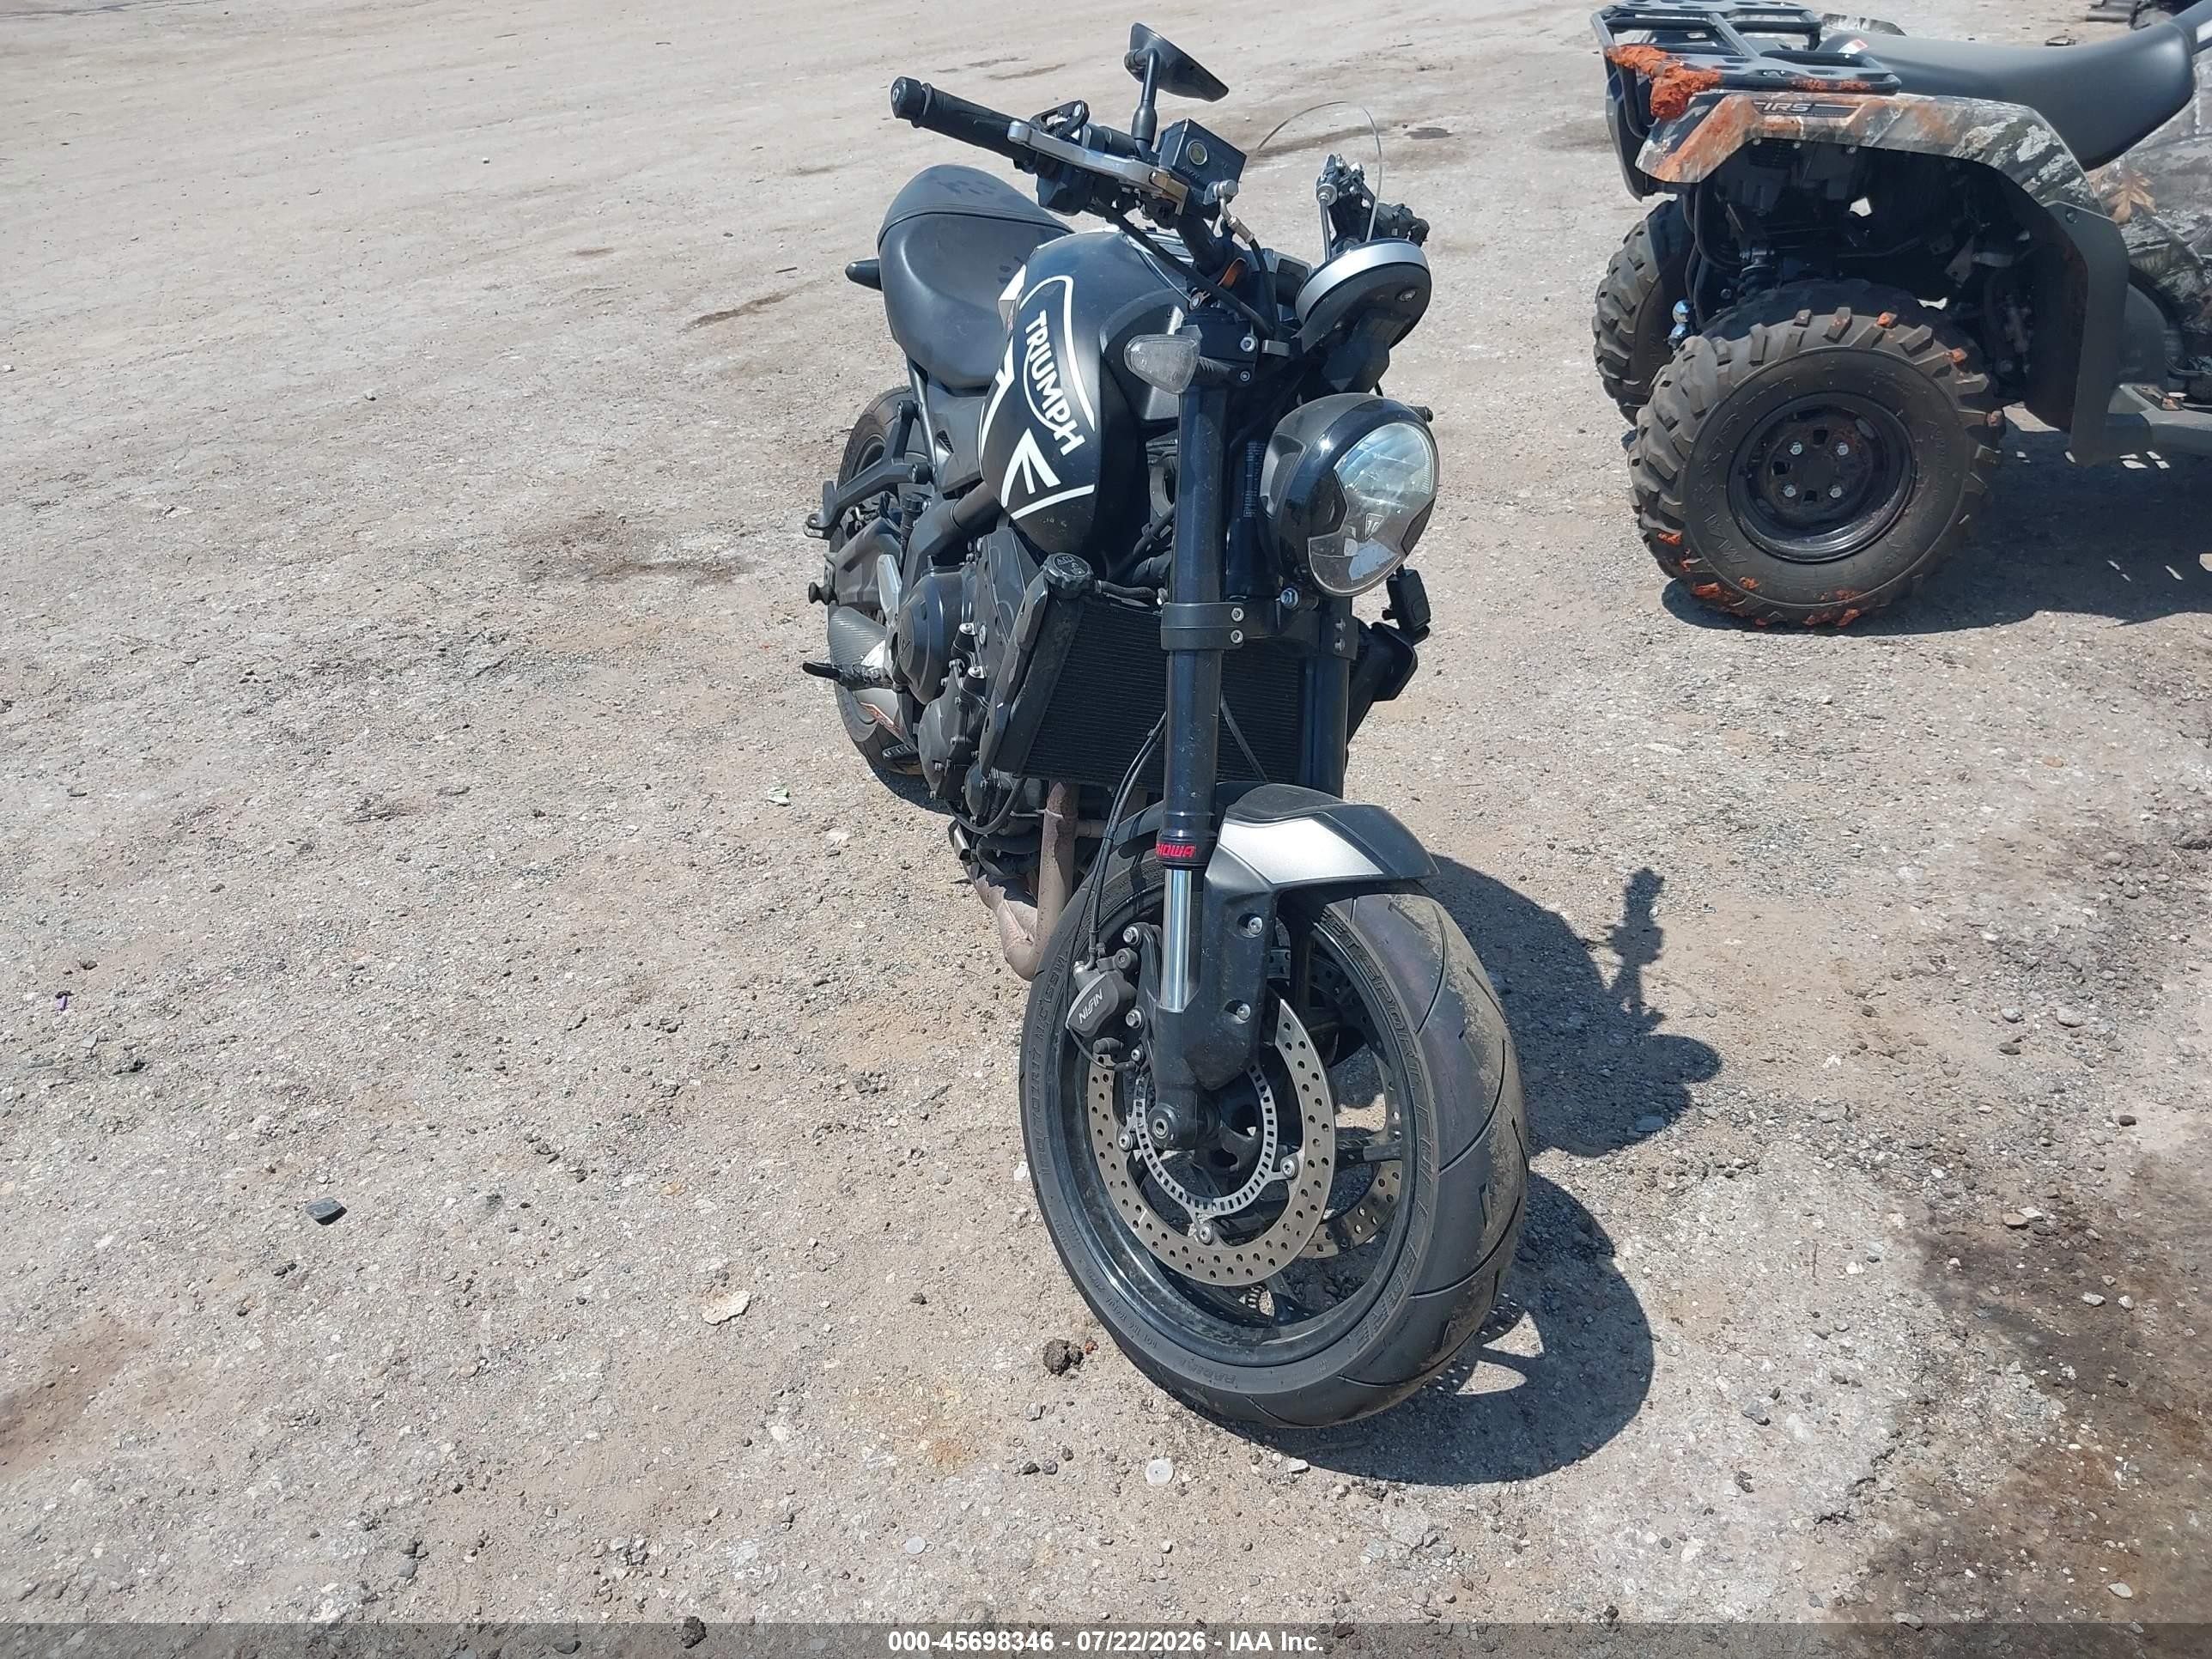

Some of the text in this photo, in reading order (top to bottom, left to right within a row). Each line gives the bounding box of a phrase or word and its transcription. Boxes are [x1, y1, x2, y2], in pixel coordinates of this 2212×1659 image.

[1764, 102, 1812, 112] IRS
[1025, 309, 1086, 456] TRIUMPH
[1155, 842, 1197, 858] HOWA
